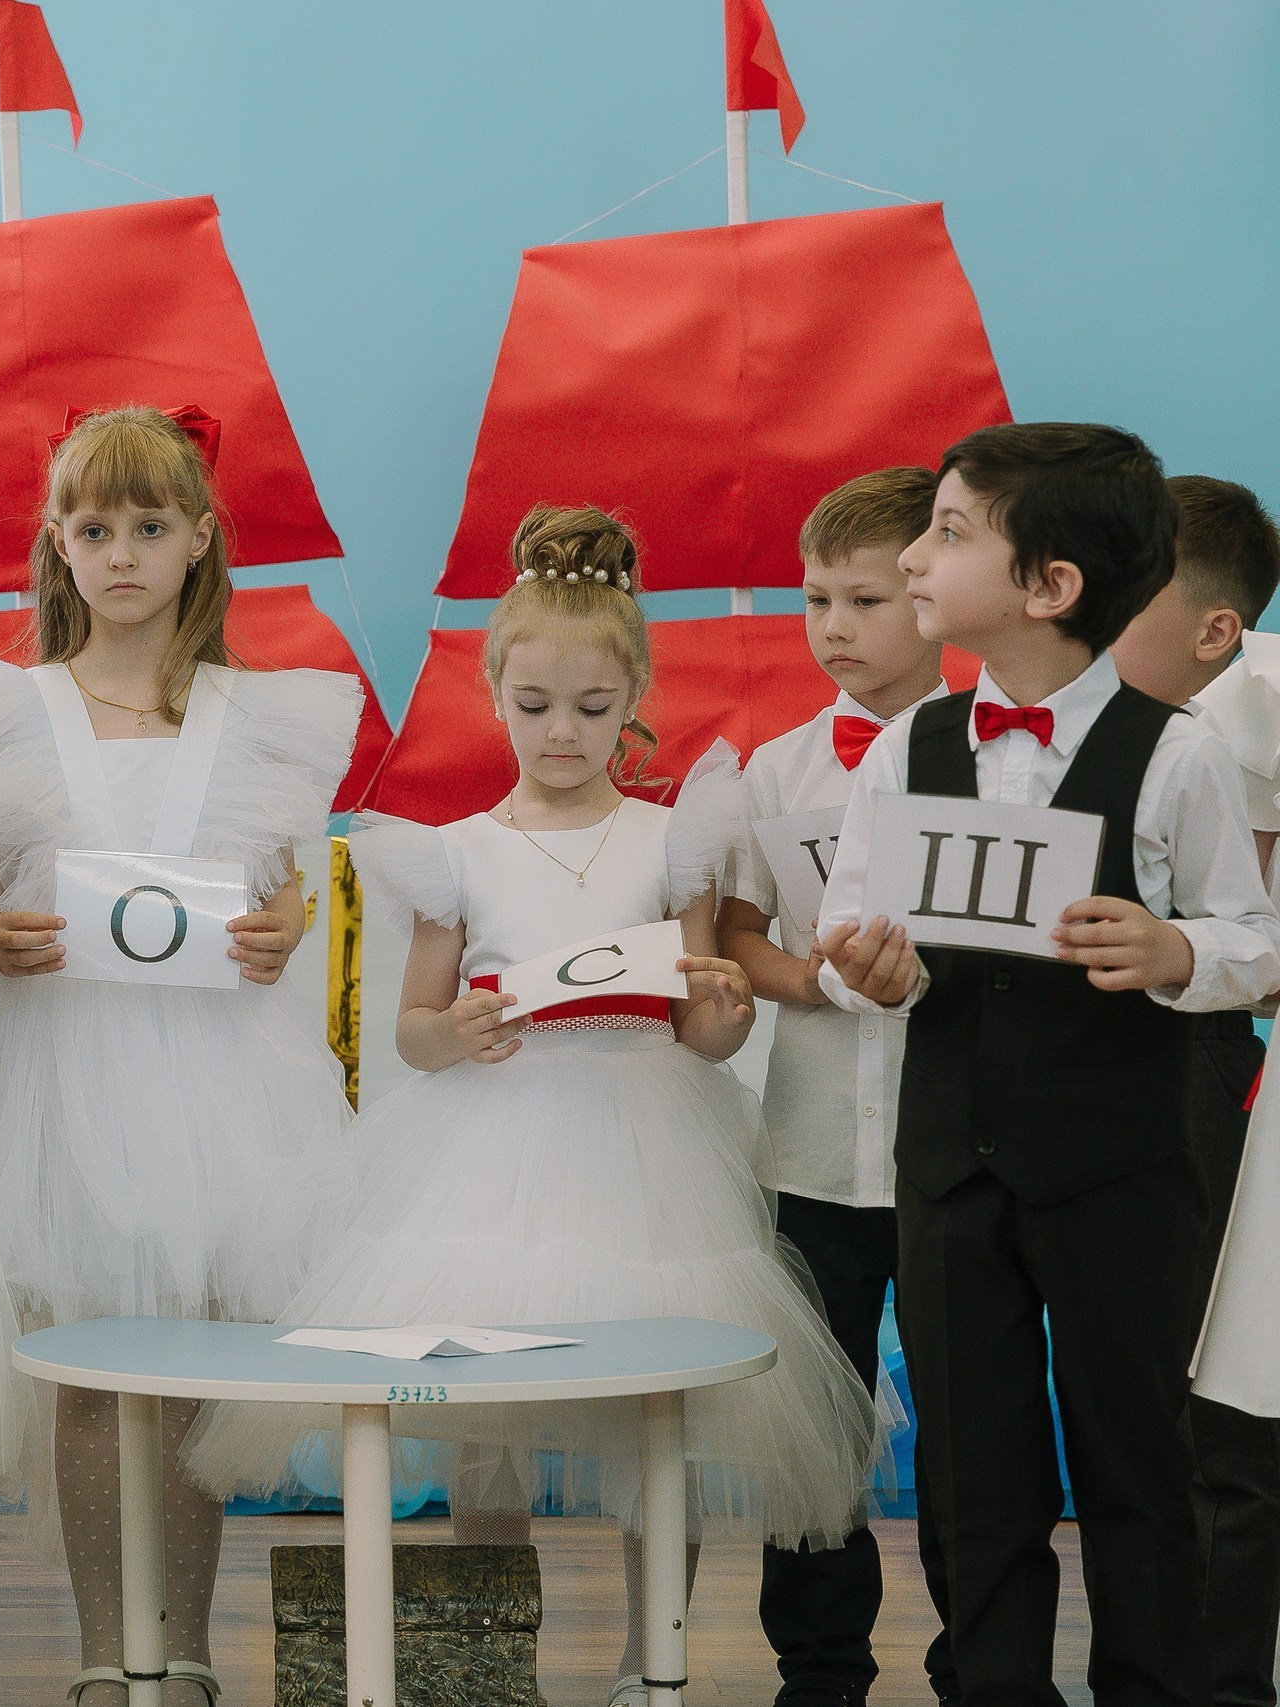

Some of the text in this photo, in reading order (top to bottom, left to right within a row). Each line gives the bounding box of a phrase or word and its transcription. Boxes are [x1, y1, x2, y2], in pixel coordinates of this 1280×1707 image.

[908, 830, 1049, 928] Ш
[110, 885, 188, 964] О
[556, 943, 628, 987] С
[387, 1385, 448, 1402] 53723
